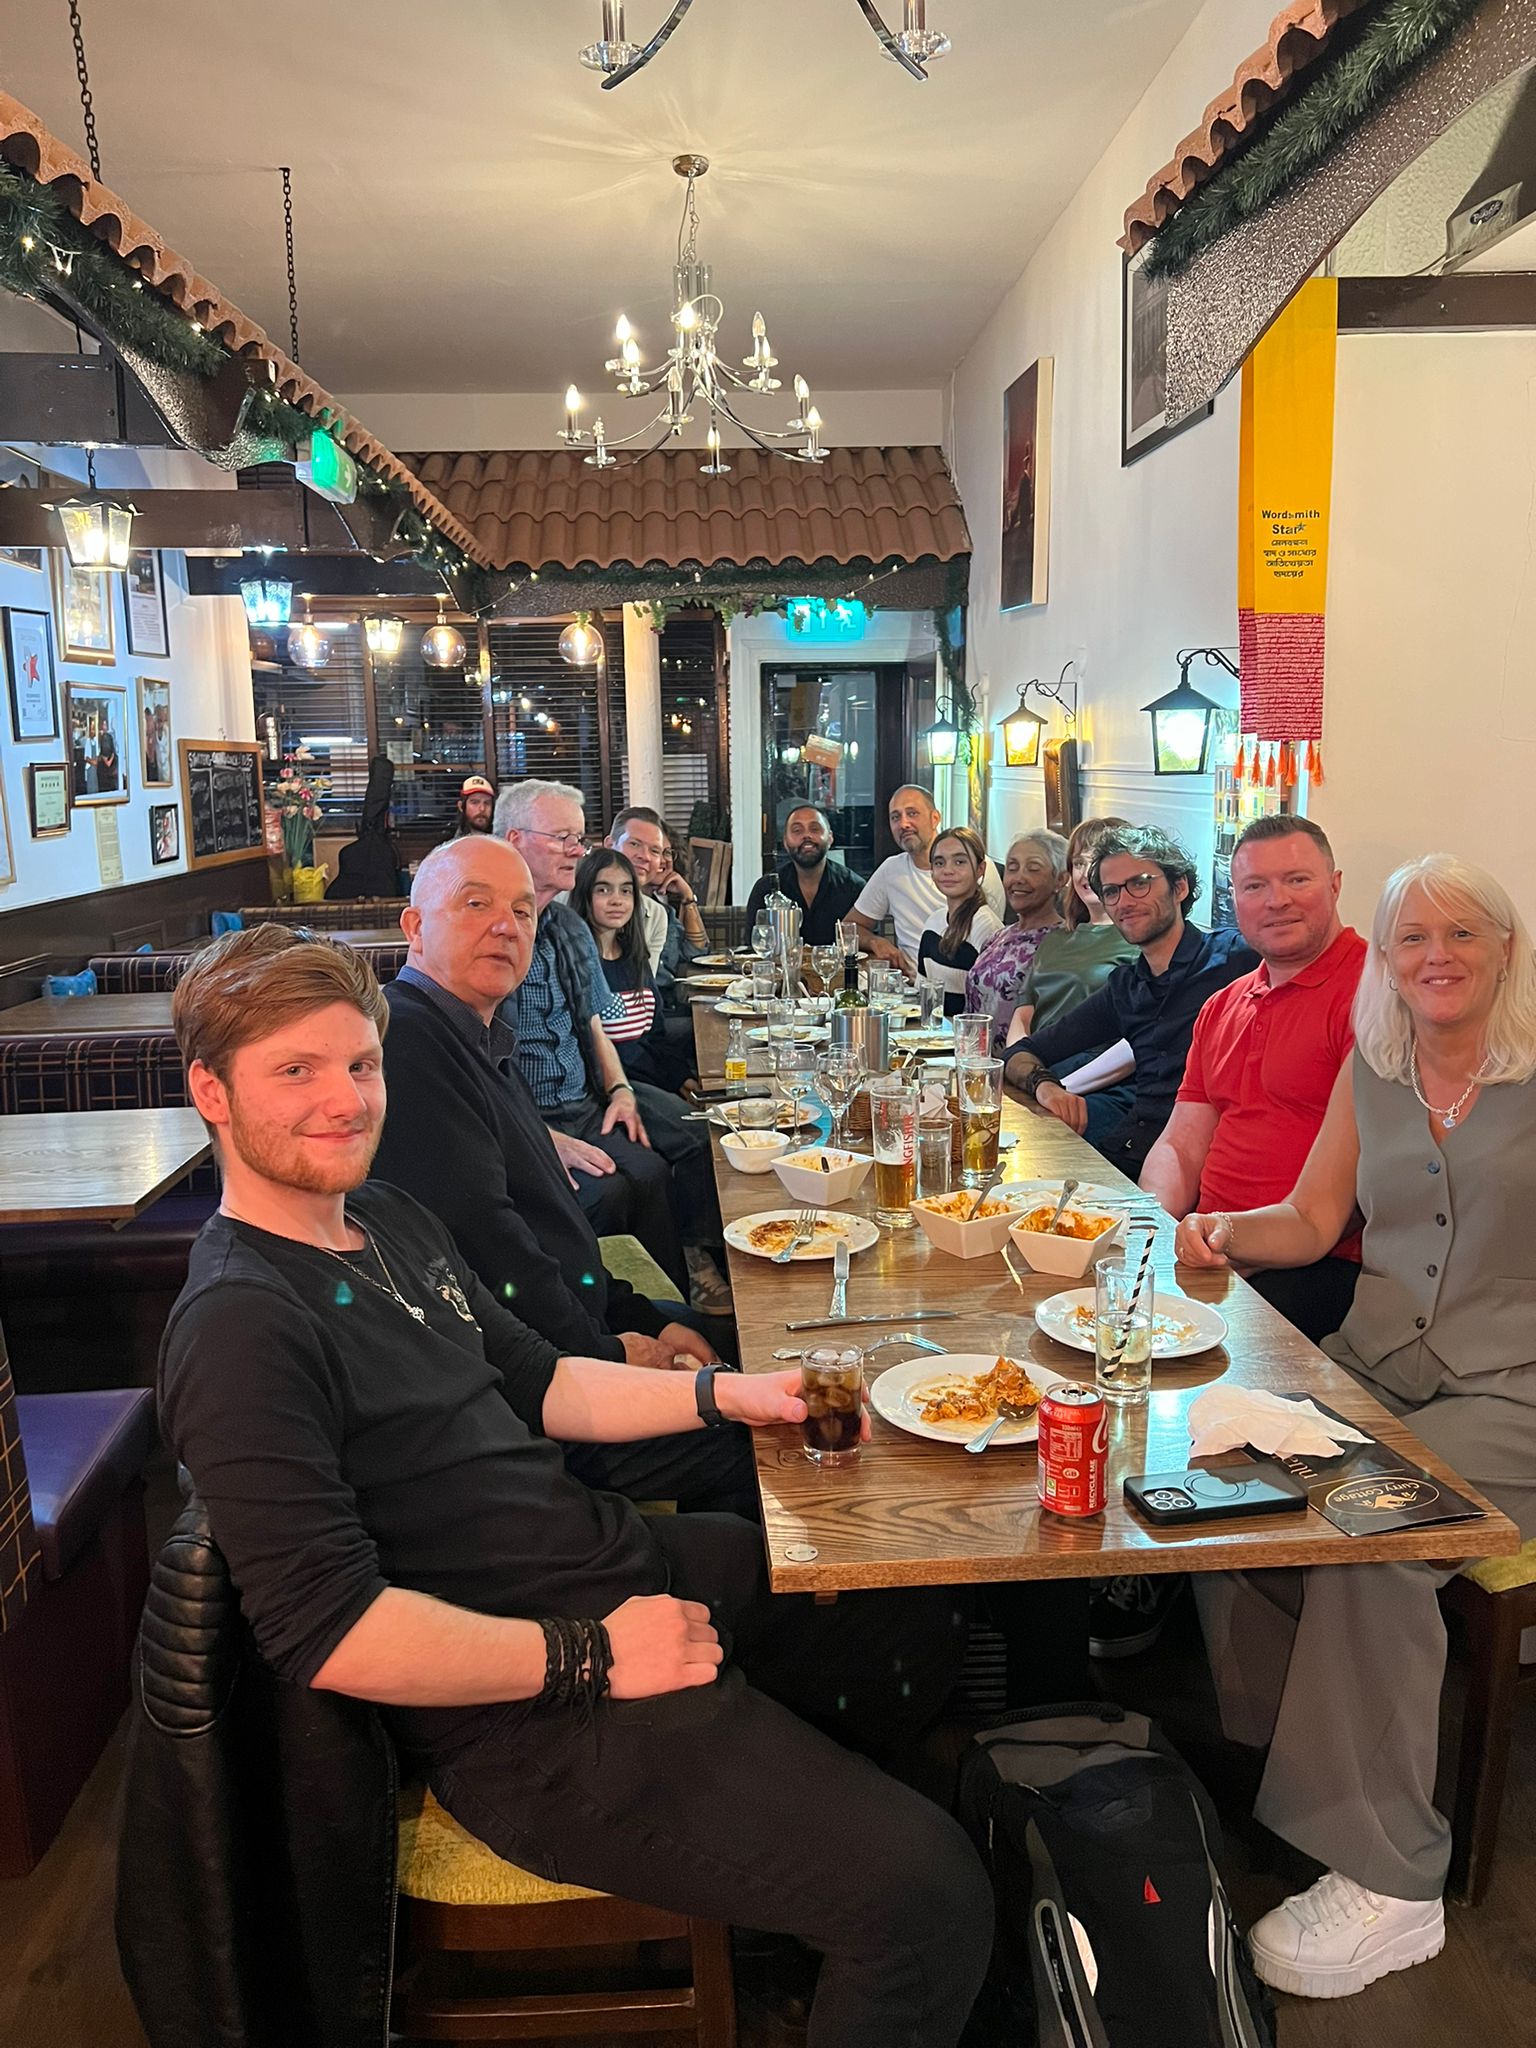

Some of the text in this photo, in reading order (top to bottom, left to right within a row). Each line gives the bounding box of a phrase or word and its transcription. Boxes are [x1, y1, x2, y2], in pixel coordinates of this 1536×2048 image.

[1272, 524, 1298, 535] Star
[1385, 1482, 1420, 1494] Curry
[1333, 1488, 1384, 1503] Cottage
